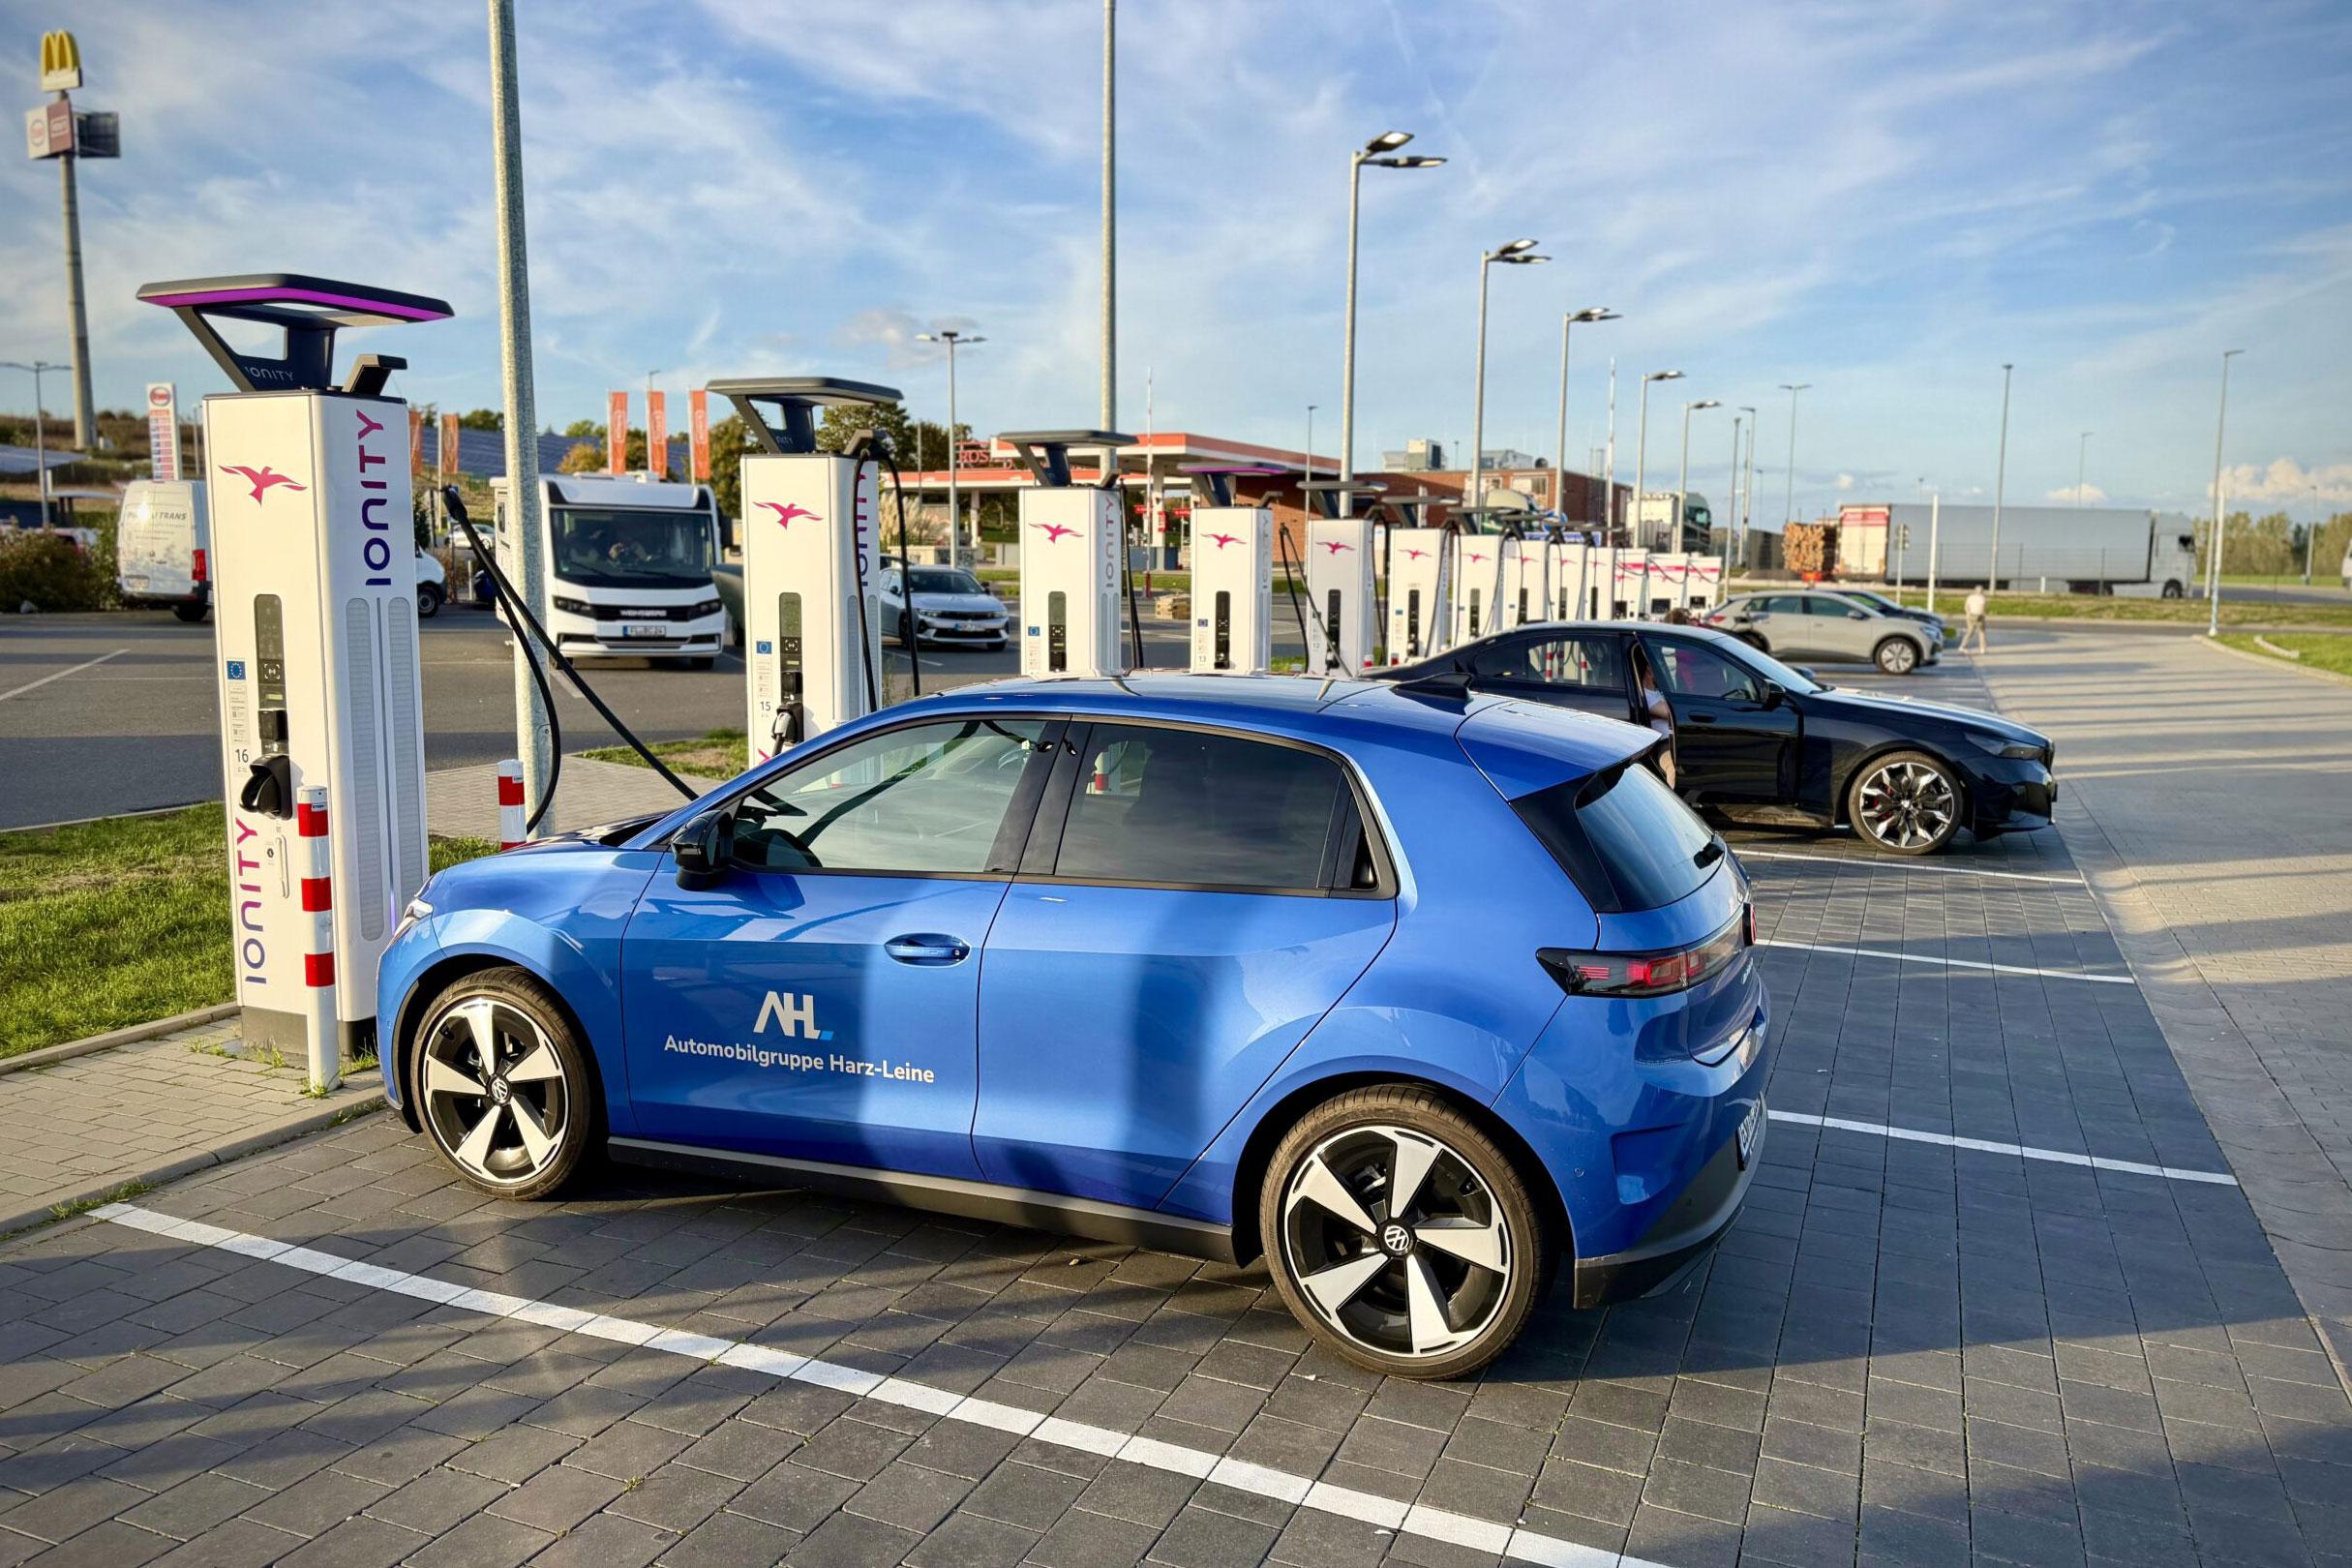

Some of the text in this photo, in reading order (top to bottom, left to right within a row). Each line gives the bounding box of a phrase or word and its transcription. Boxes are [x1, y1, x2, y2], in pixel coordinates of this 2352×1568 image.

[244, 366, 293, 381] IONITY
[959, 449, 989, 464] ROS
[356, 408, 392, 586] IONITY
[159, 512, 187, 521] TRANS
[1105, 496, 1114, 588] IONITY
[760, 701, 771, 711] 15
[235, 748, 249, 763] 16
[235, 817, 267, 984] IONITY
[664, 1035, 935, 1083] Automobilgruppe Harz-Leine
